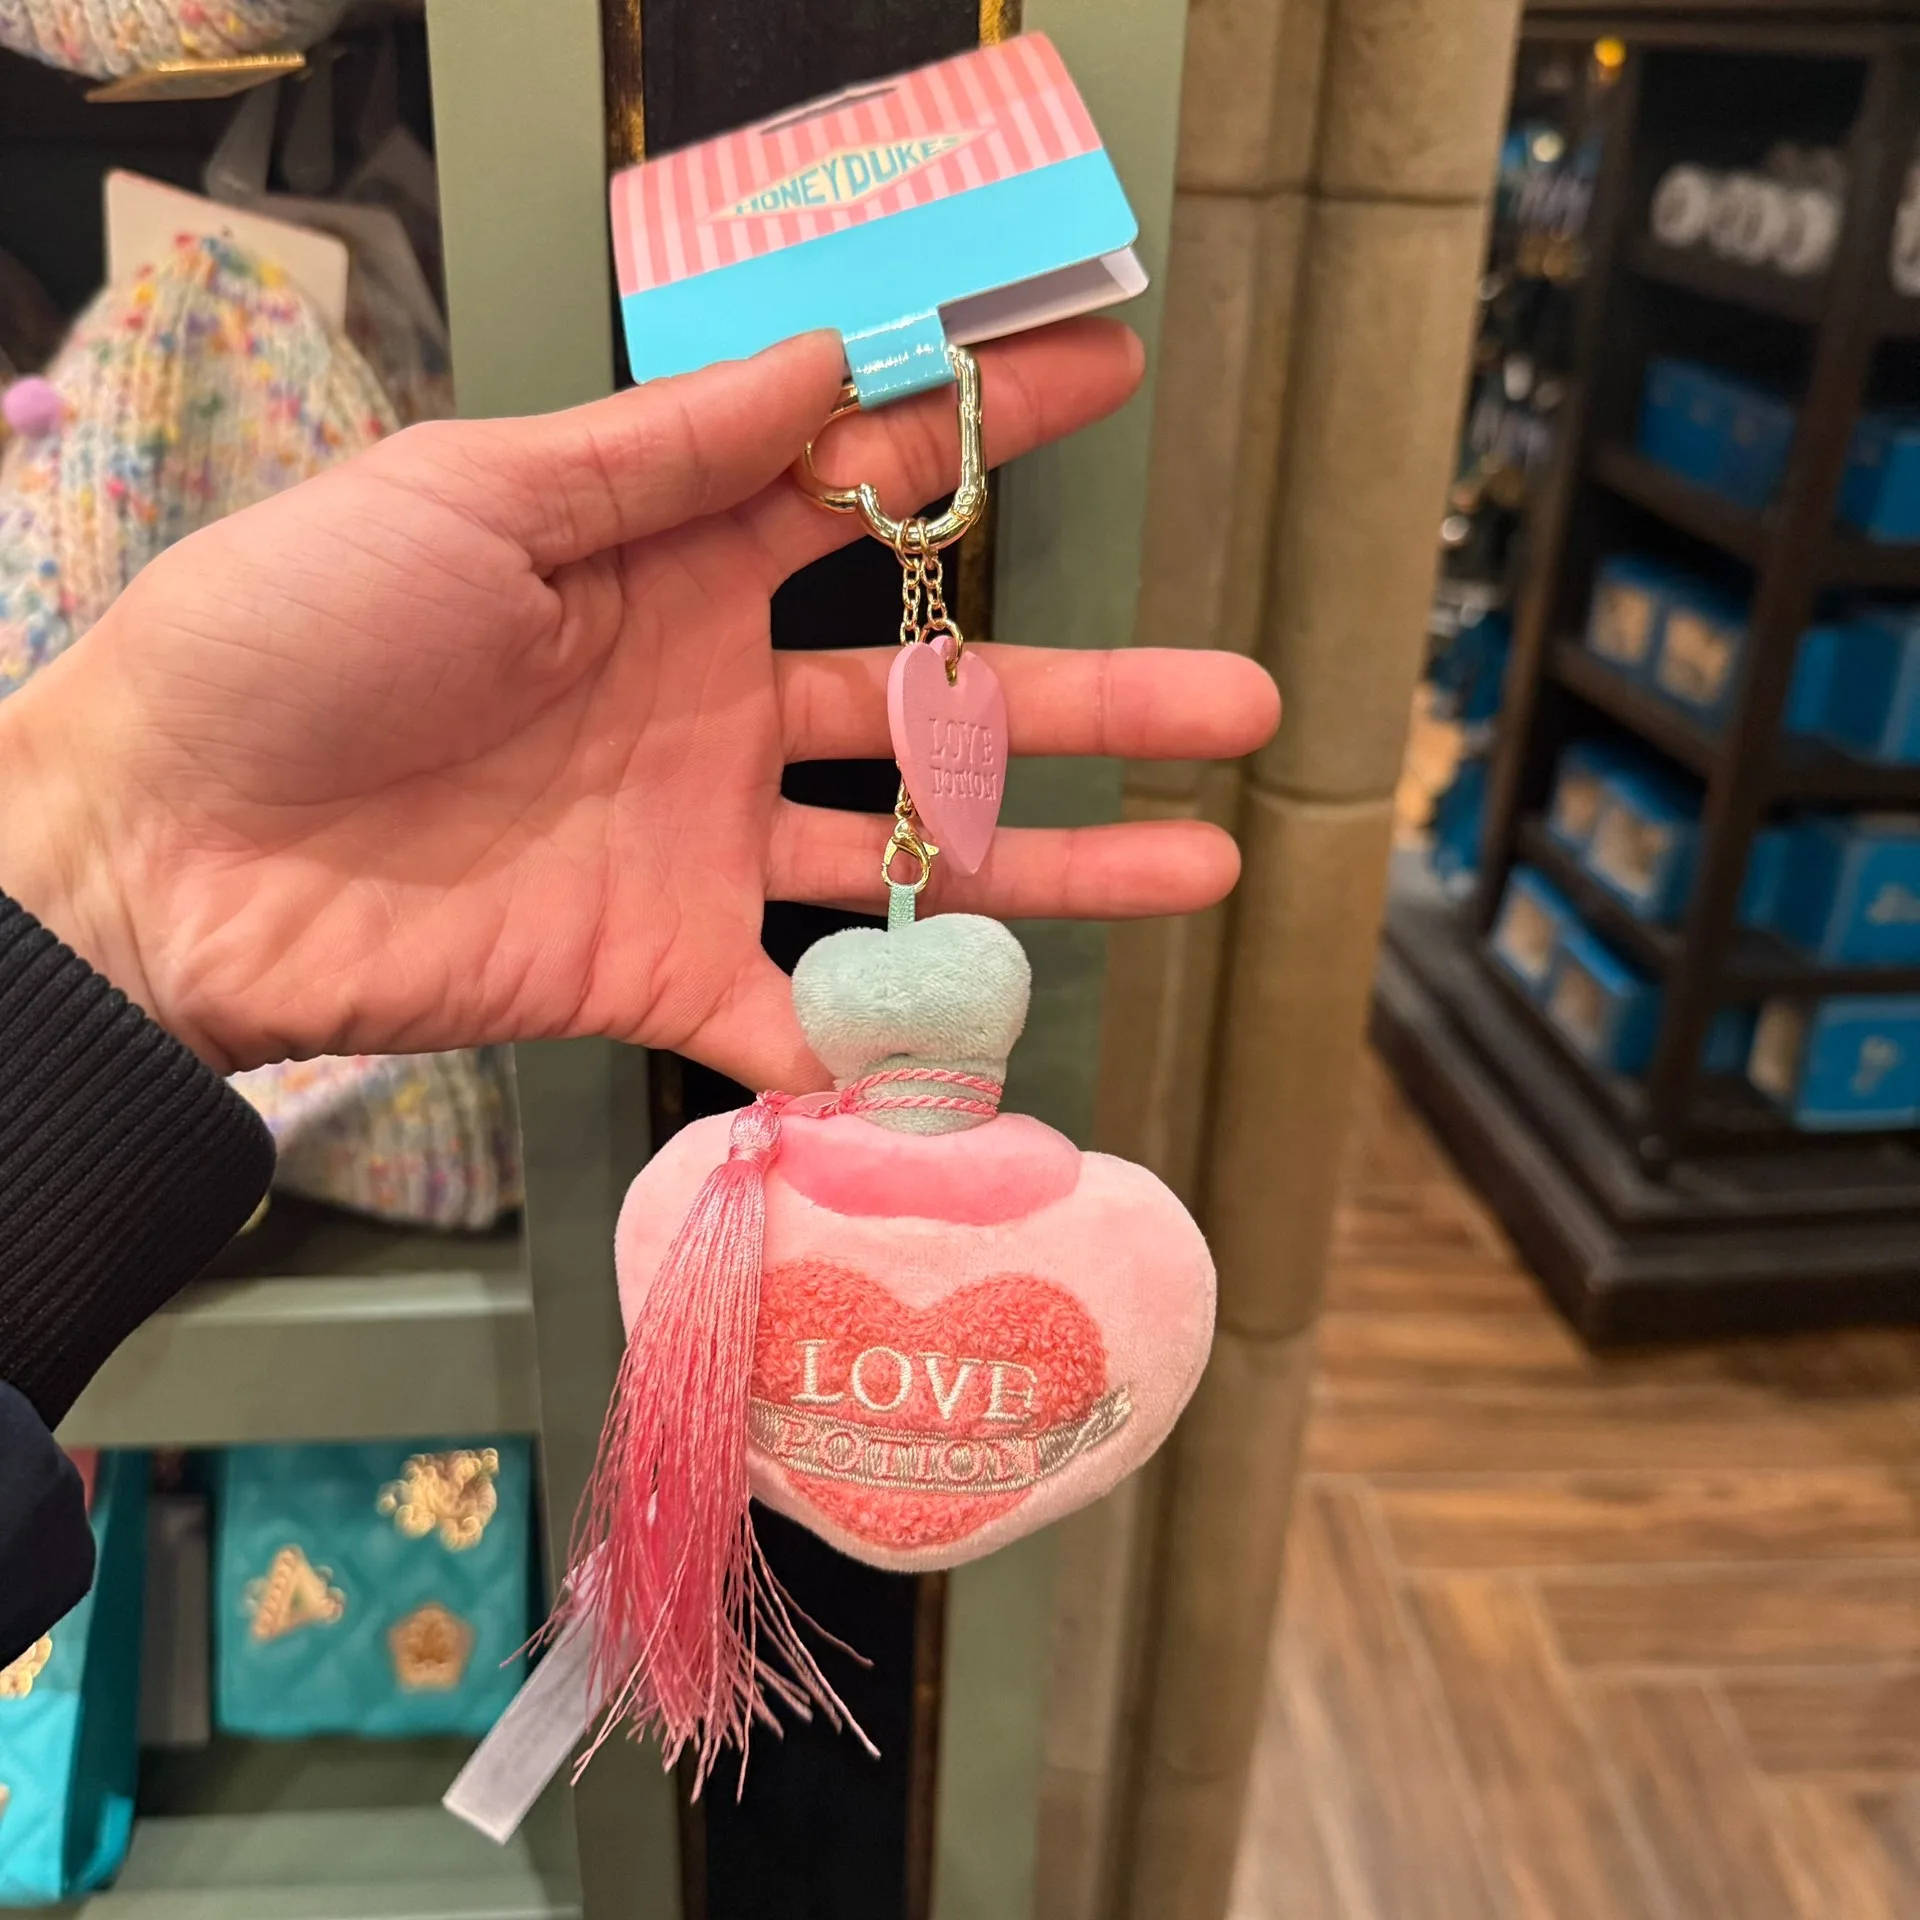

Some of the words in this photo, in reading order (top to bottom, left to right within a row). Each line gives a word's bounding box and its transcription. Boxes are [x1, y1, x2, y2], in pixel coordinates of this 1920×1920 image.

[929, 717, 994, 765] LOVE
[930, 765, 998, 800] POTION
[791, 1338, 1038, 1422] LOVE
[777, 1417, 1040, 1483] POTION
